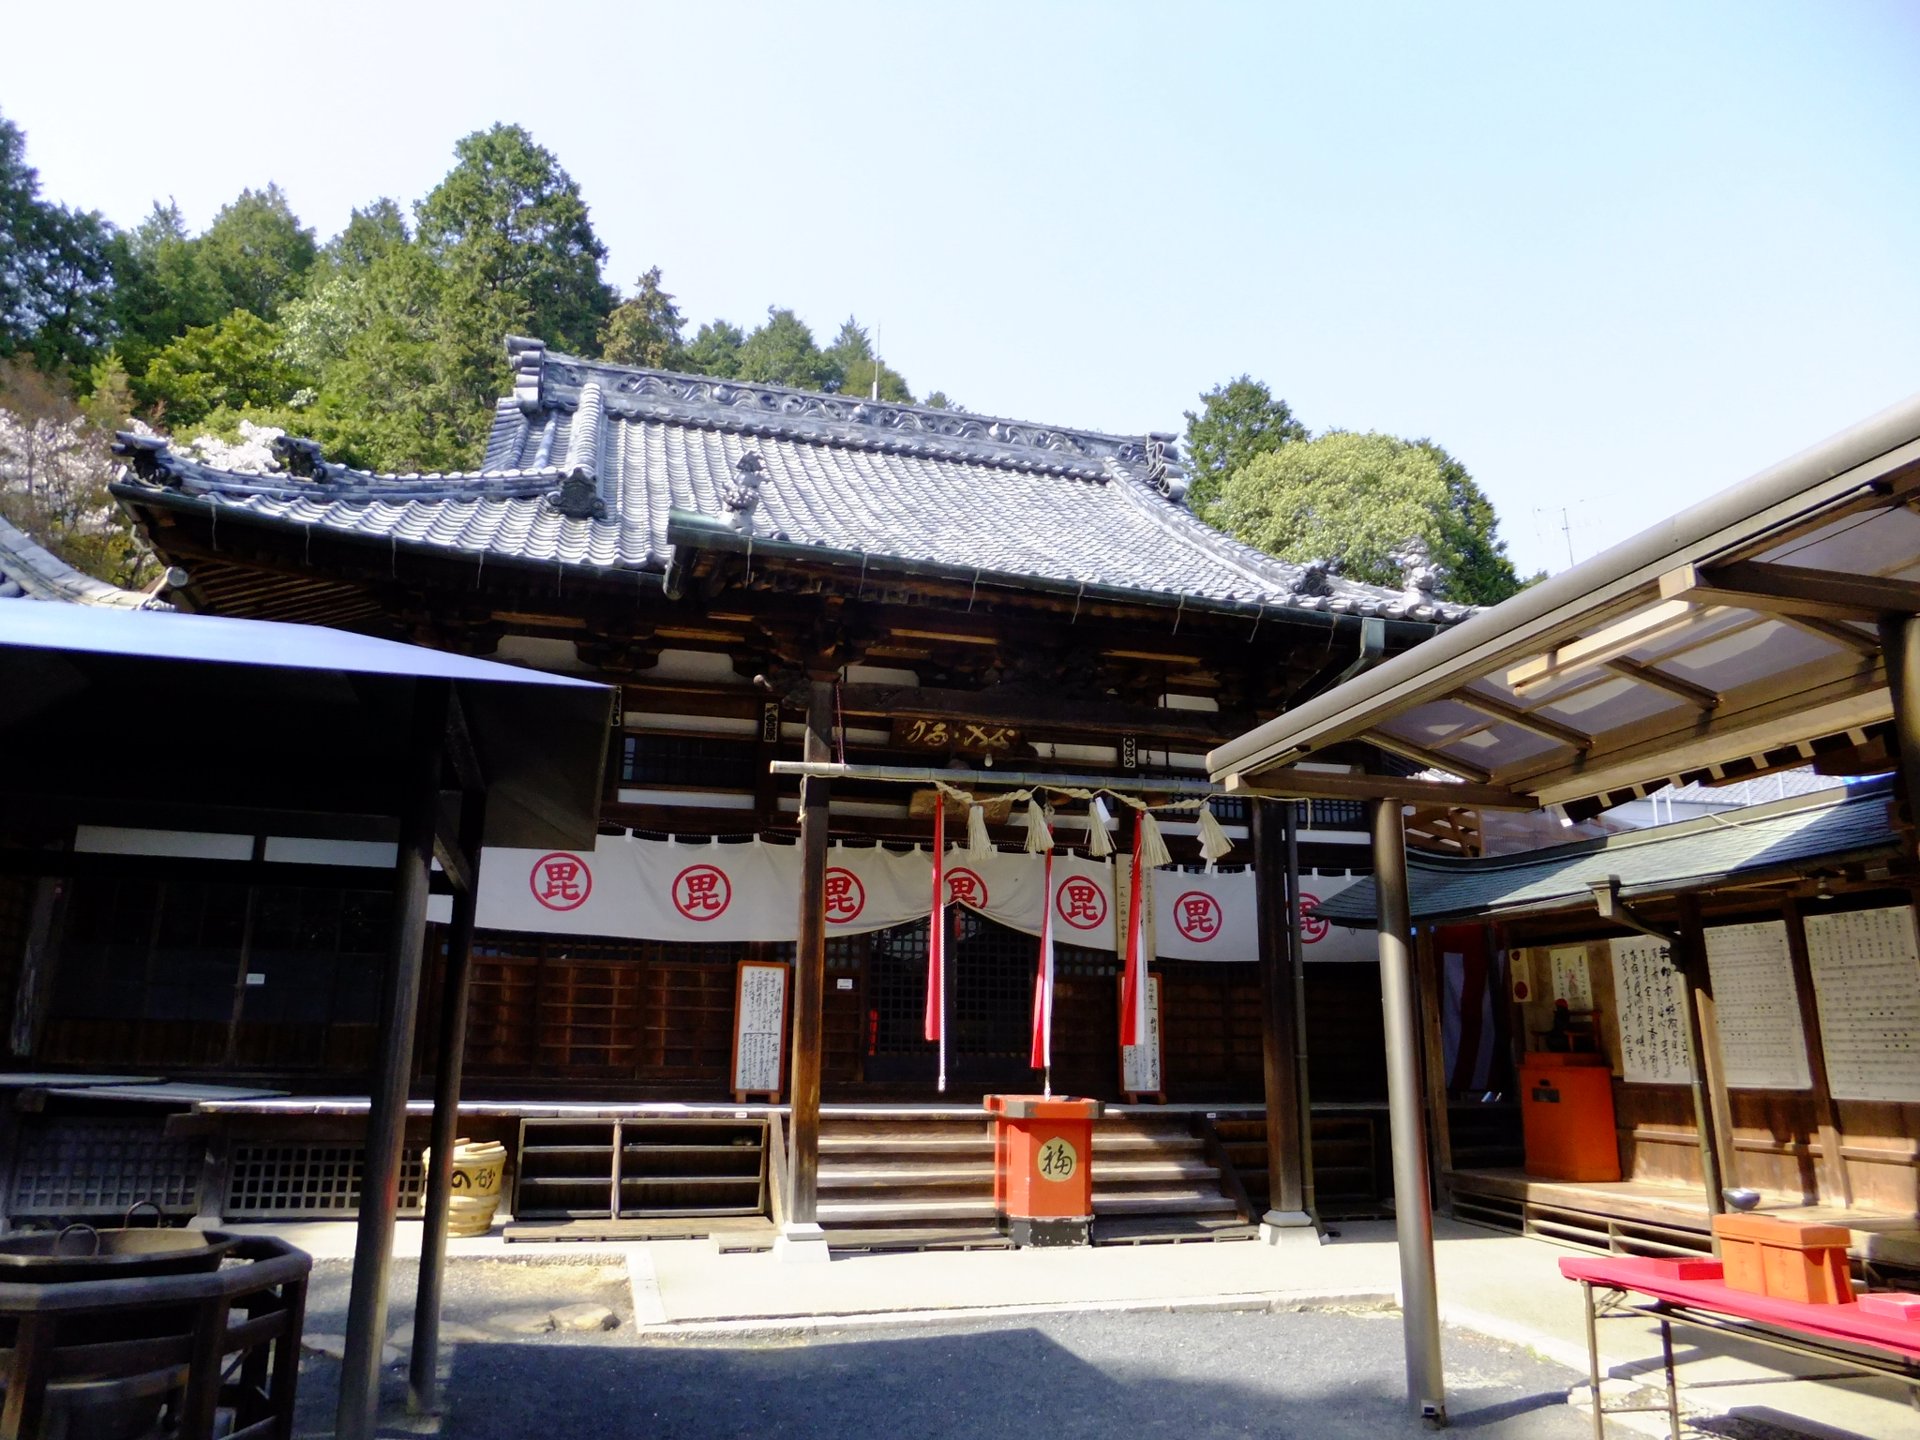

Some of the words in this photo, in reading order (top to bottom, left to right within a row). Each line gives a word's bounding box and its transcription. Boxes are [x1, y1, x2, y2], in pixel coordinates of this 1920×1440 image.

[541, 862, 580, 901] 毘
[683, 871, 721, 911] 毘
[1066, 885, 1099, 921] 毘
[1183, 898, 1214, 933] 毘
[1042, 1144, 1073, 1175] 福
